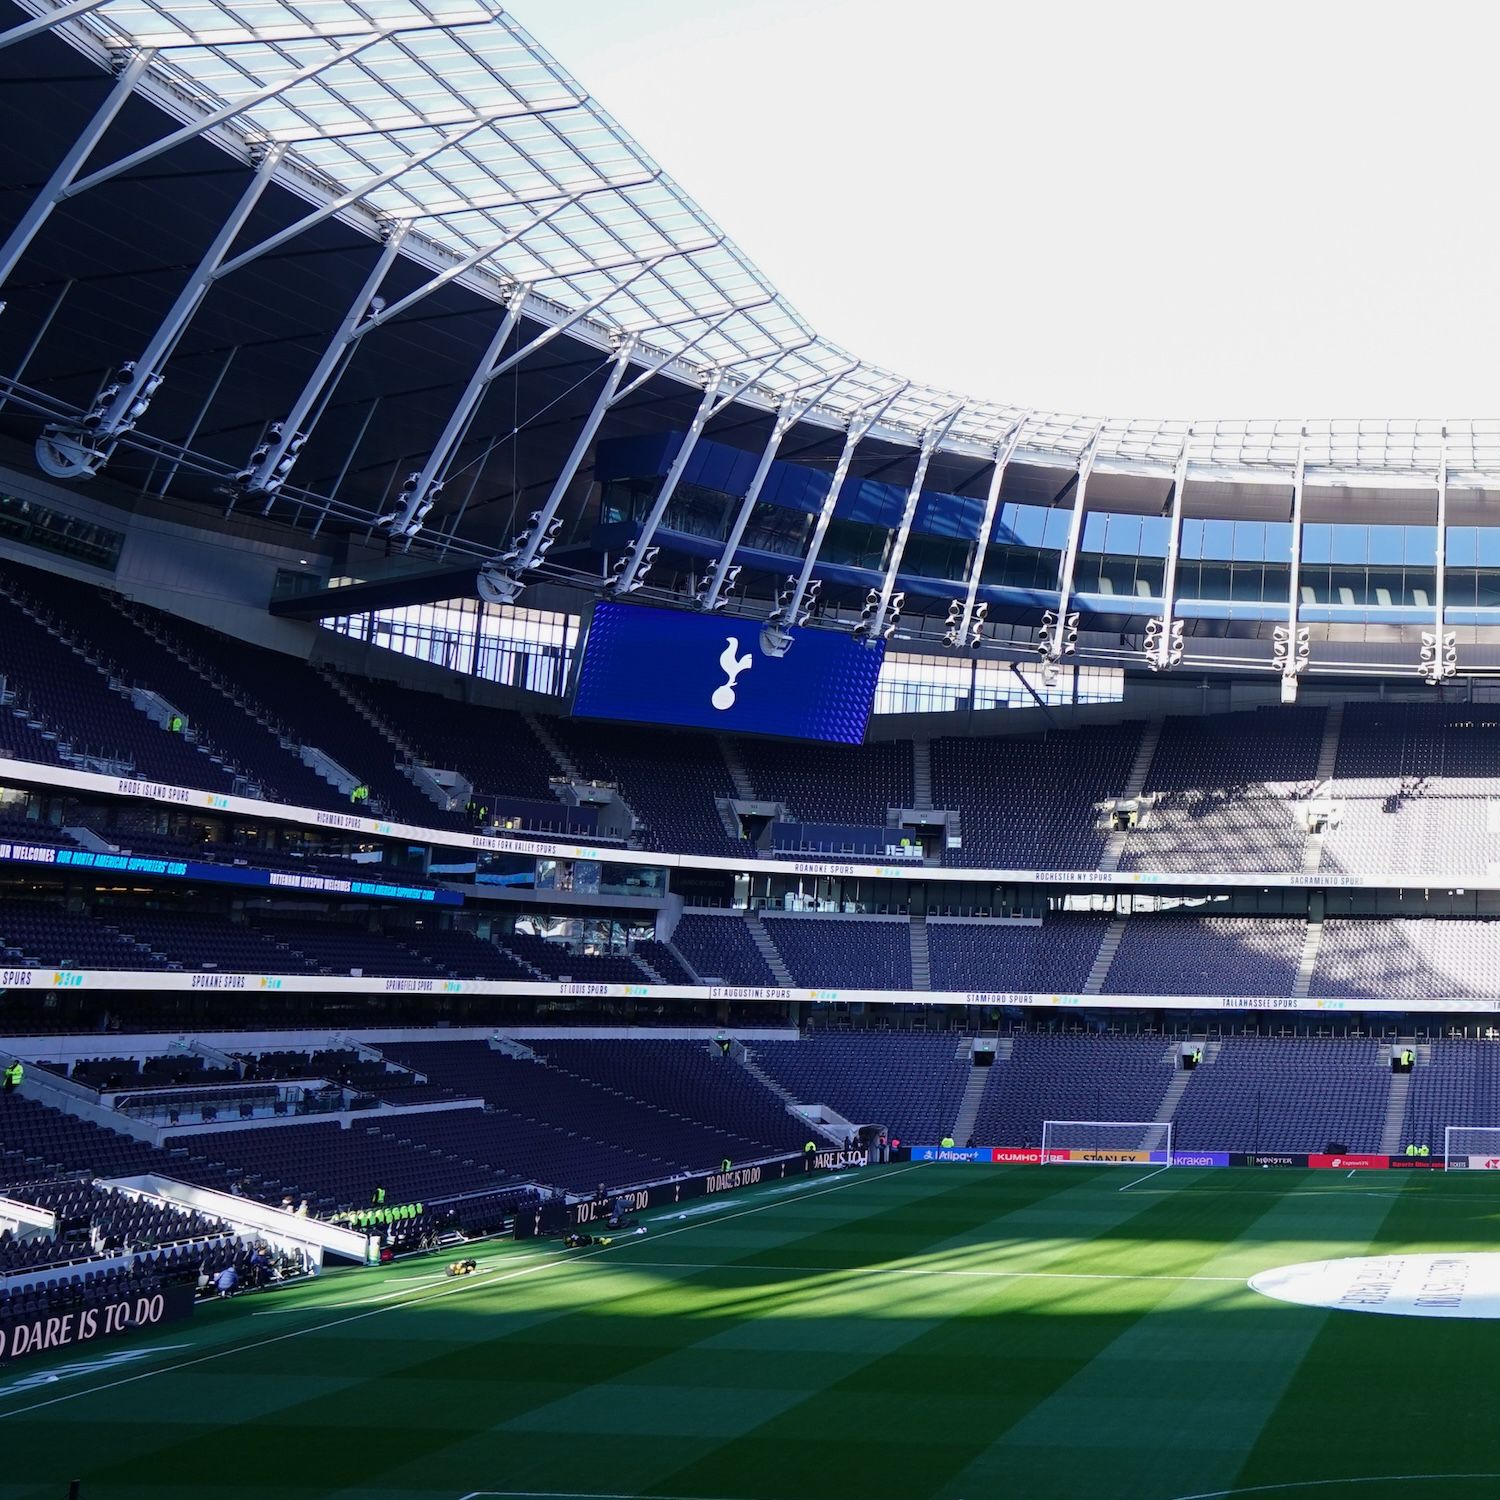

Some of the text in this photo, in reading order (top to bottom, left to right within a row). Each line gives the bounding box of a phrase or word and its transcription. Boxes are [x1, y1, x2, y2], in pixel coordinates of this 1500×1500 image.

[119, 780, 141, 795] RHODE
[143, 783, 166, 799] ISLAND
[168, 788, 190, 802] SPURS
[316, 812, 344, 827] RICHMOND
[345, 817, 361, 829] SPURS
[472, 836, 556, 855] ROARING FORK VALLEY SPURS
[13, 845, 55, 863] WELCOMES
[56, 850, 71, 864] OUR
[71, 852, 95, 866] NORTH
[93, 854, 129, 870] AMERICAN
[167, 862, 188, 875] CLUBS
[794, 863, 854, 874] ROANOKE SPURS
[269, 873, 300, 887] TOTTENHAM
[1035, 872, 1075, 881] ROCHESTER
[1089, 873, 1112, 882] SPURS
[1290, 876, 1363, 886] SACRAMENTO SPURS
[2, 971, 31, 986] SPURS
[191, 975, 245, 988] SPOKANE SPURS
[417, 981, 433, 991] SPURS
[569, 985, 585, 994] LOUIS
[587, 985, 608, 995] SPURS
[713, 988, 791, 998] ST AUGUSTINE SPURS
[967, 994, 1033, 1004] STAMFORD SPURS
[1222, 998, 1298, 1008] TALLAHASSEE SPURS
[997, 1153, 1038, 1161] KUMHO
[1176, 1155, 1213, 1166] kraken
[706, 1177, 715, 1193] TO
[734, 1171, 741, 1187] IS
[742, 1169, 750, 1185] TO
[751, 1167, 761, 1183] DO
[576, 1203, 589, 1224] TO
[636, 1190, 649, 1210] DO
[11, 1314, 74, 1357] DARE
[78, 1308, 98, 1340] IS
[105, 1301, 130, 1334] TO
[135, 1294, 164, 1327] DO
